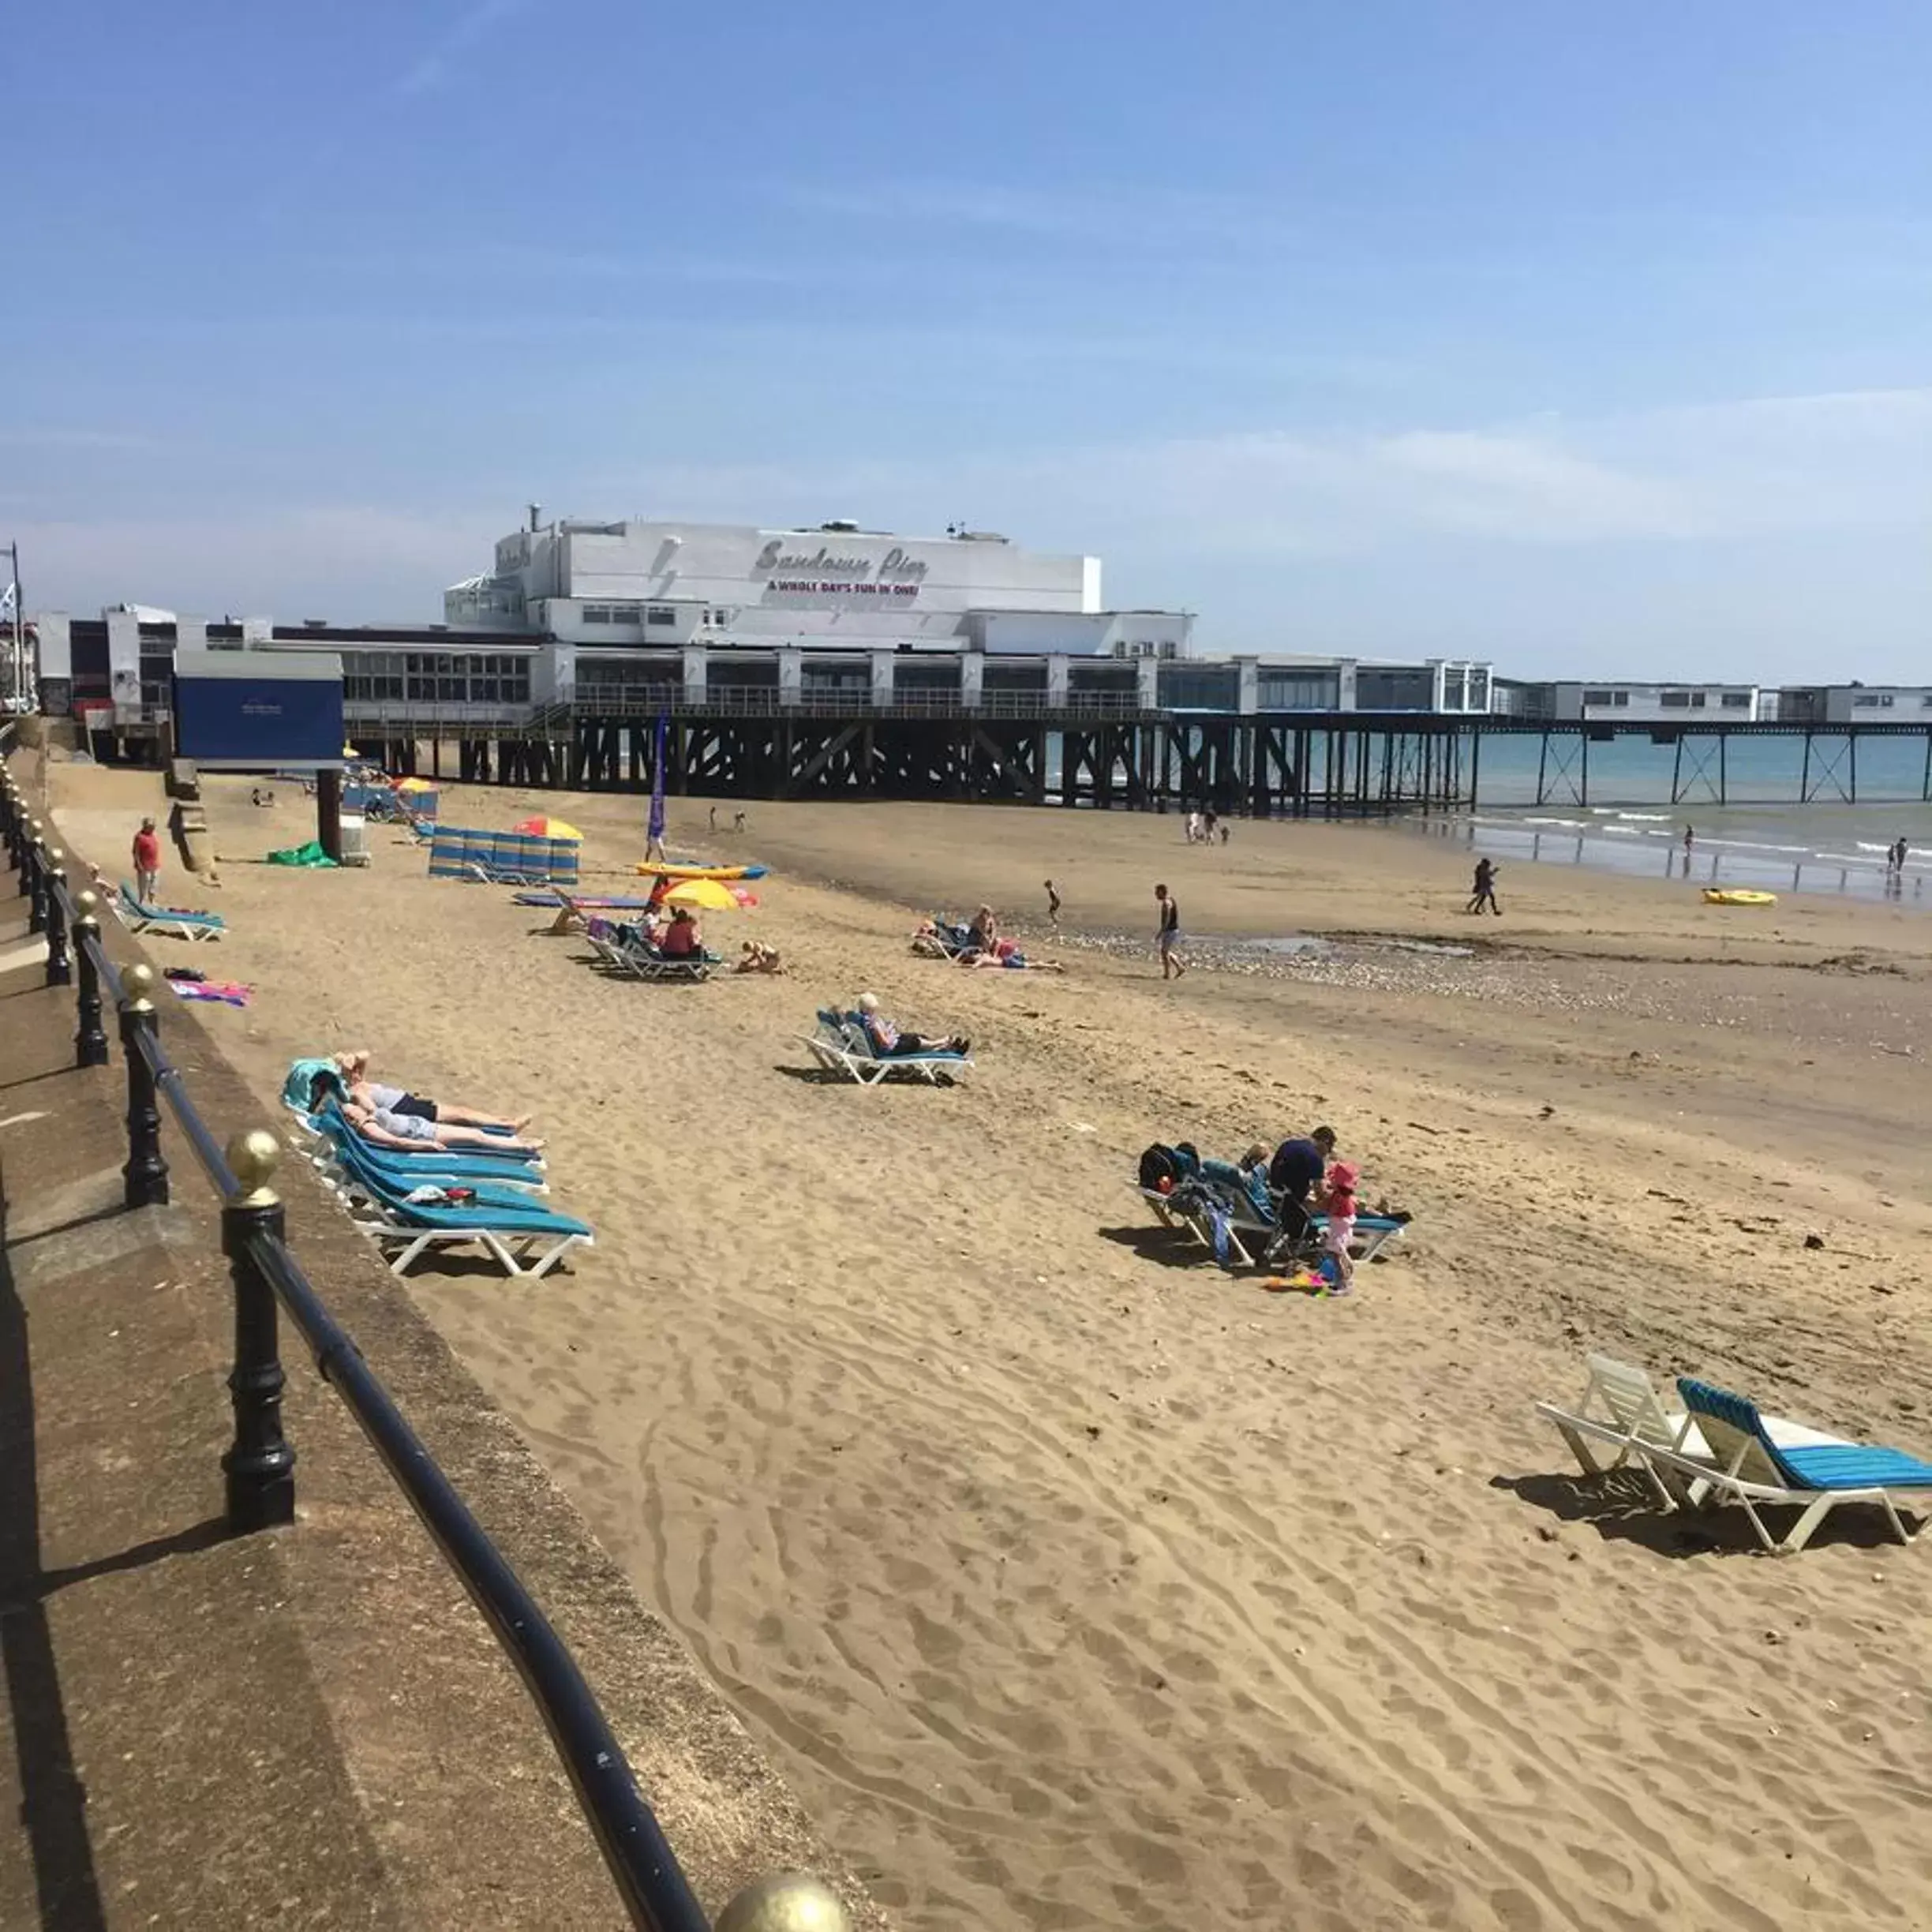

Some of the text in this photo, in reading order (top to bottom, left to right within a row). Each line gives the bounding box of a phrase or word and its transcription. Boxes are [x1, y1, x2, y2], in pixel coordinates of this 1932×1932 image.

[756, 541, 930, 575] Sandown Pier
[768, 581, 776, 591] A
[779, 581, 818, 592] WHOLE
[855, 584, 876, 594] FUN
[878, 585, 890, 594] IN
